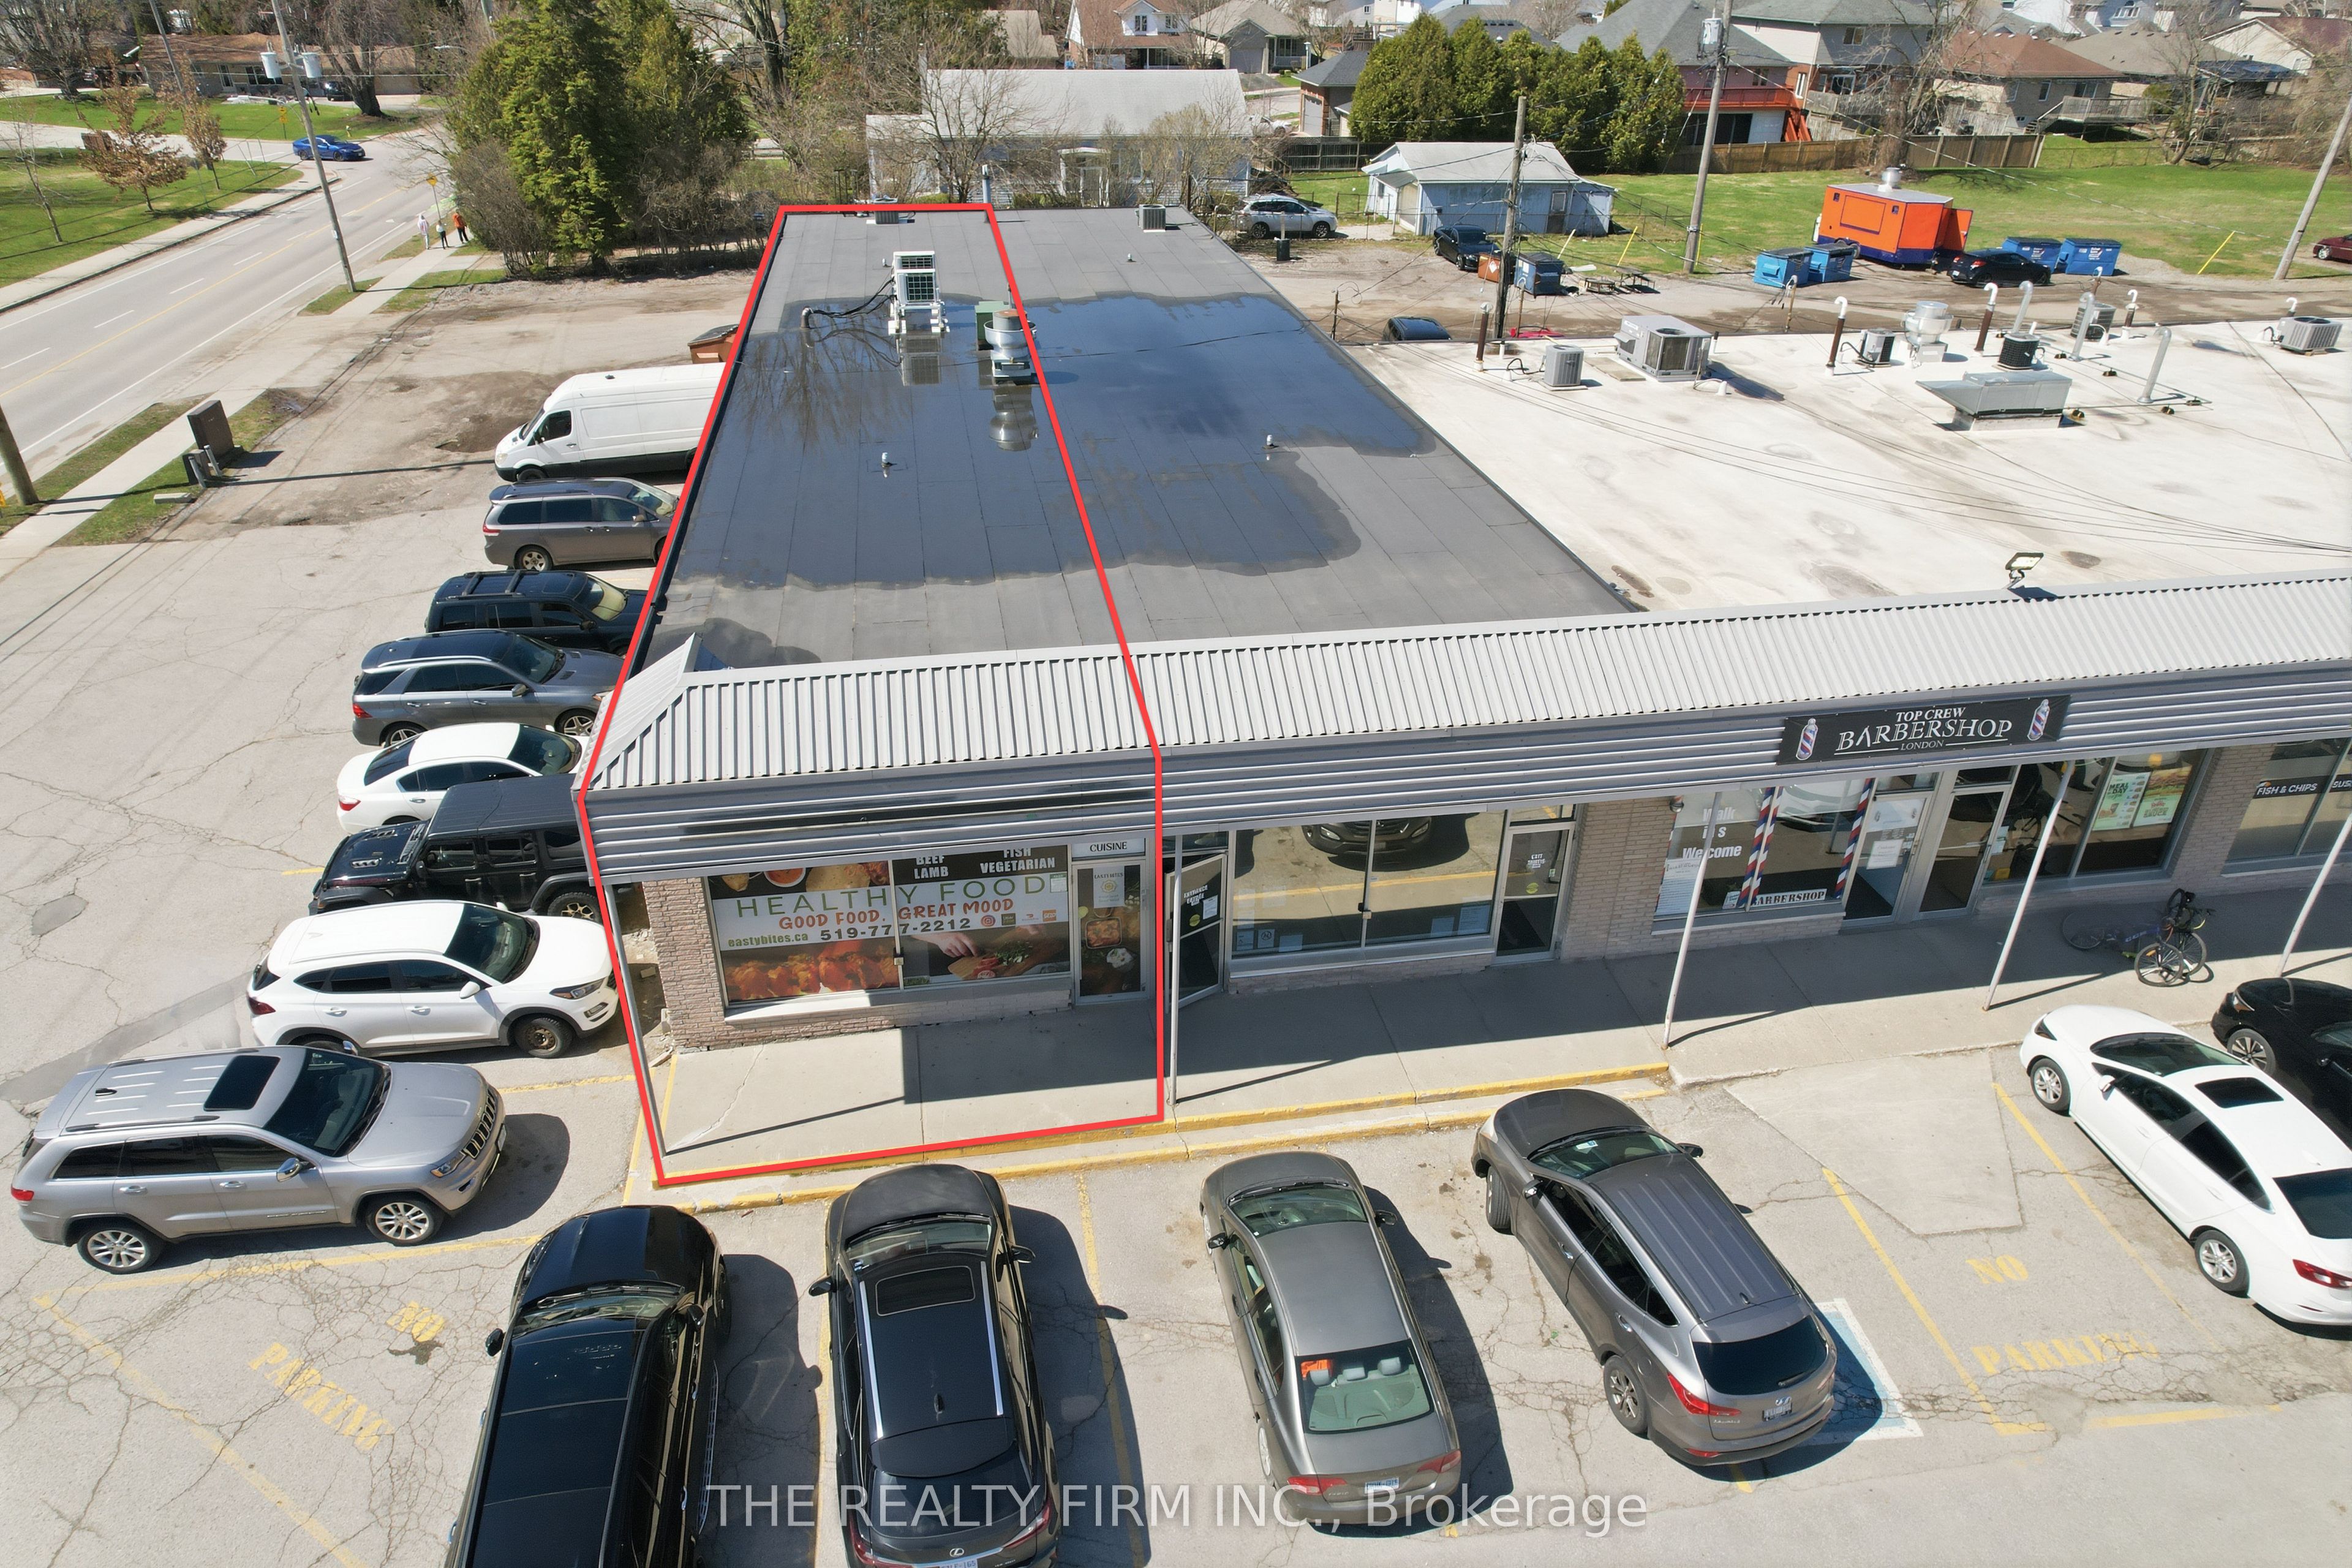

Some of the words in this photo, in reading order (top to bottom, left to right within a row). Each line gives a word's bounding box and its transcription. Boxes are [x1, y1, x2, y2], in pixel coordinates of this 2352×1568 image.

[1896, 710, 1923, 722] TOP
[1924, 707, 1966, 720] CREW
[1835, 718, 2013, 752] BARBERSHOP
[1901, 740, 1945, 751] LONDON
[2256, 786, 2280, 796] FISH
[2279, 785, 2287, 794] &
[2288, 783, 2318, 793] CHIPS
[1090, 842, 1128, 852] CUISINE
[1683, 845, 1742, 859] Wecome
[914, 866, 949, 879] LAMB
[980, 858, 1055, 873] VEGETARIAN
[736, 885, 918, 918] HEALTHY
[940, 876, 1045, 901] FOOD
[779, 914, 828, 930] GOOD
[898, 903, 956, 920] GREAT
[963, 899, 1014, 915] MOOD
[728, 933, 809, 947] eastybites.ca
[820, 918, 971, 940] 519-777-2212
[1966, 1254, 2029, 1284] NO
[1972, 1330, 2160, 1375] PARKING
[249, 1341, 394, 1451] PARKING
